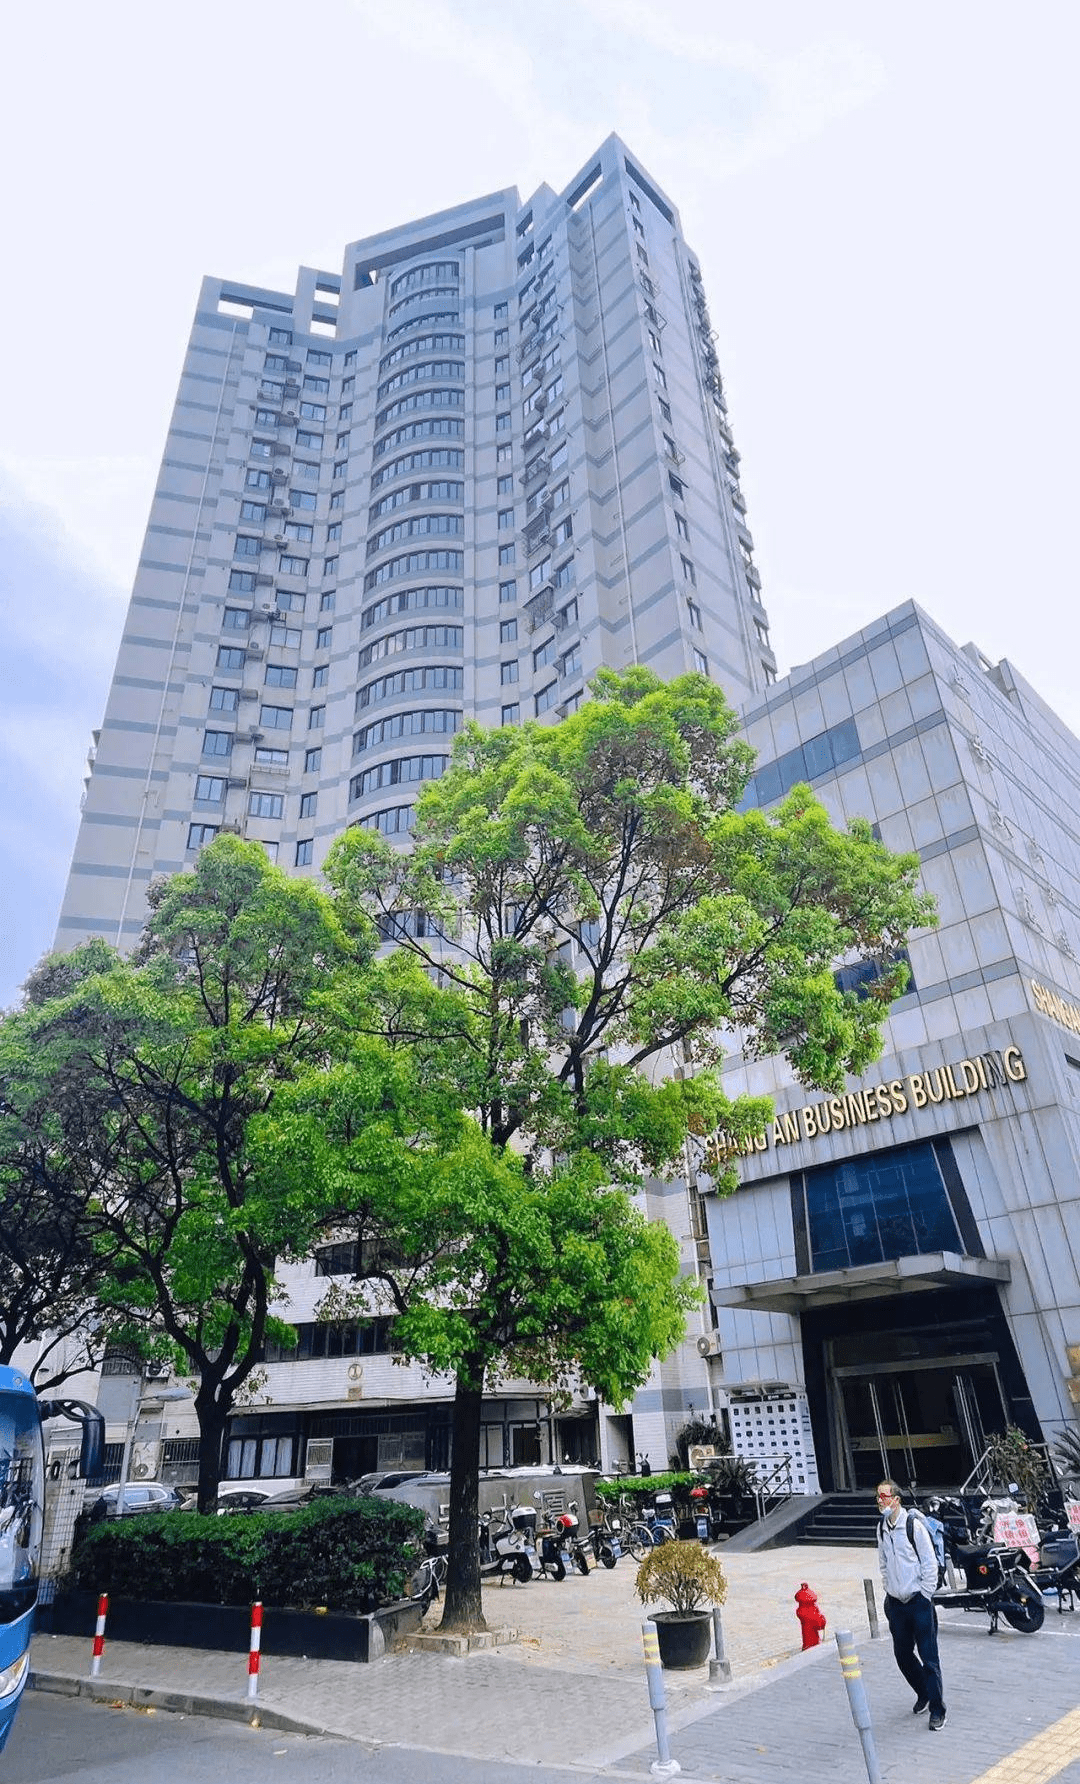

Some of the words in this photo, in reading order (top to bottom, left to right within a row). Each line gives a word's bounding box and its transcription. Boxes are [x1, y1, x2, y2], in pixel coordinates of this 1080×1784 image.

[773, 1108, 802, 1147] AN
[802, 1080, 909, 1138] BUSINESS
[908, 1045, 1028, 1109] BUILDING
